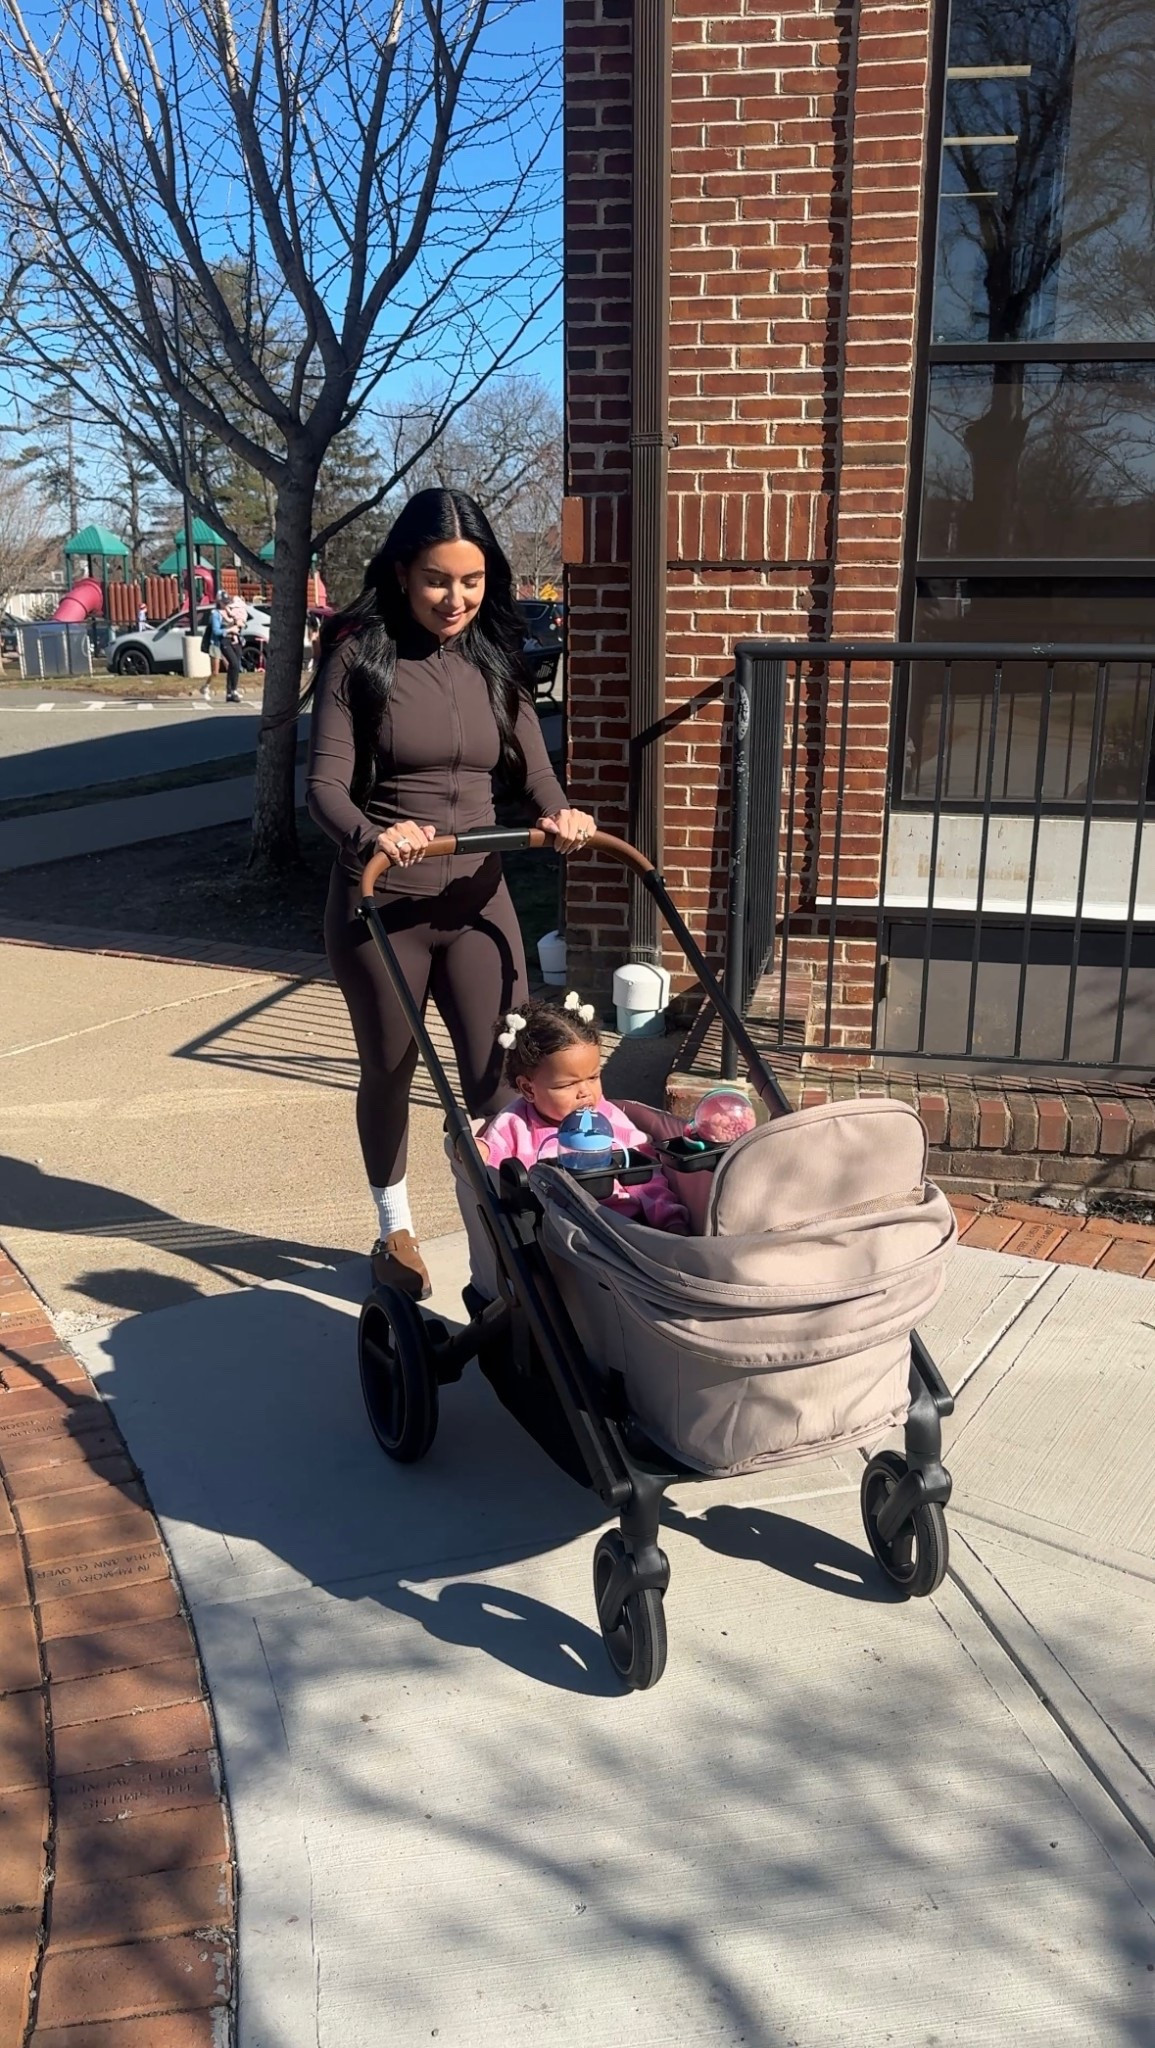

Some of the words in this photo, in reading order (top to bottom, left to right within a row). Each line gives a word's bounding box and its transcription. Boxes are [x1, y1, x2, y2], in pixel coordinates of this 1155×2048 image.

[93, 1558, 120, 1569] ANN
[137, 1563, 150, 1572] IN
[36, 1563, 89, 1579] GLOVER
[76, 1567, 133, 1583] MEMORY
[55, 1577, 72, 1587] OF
